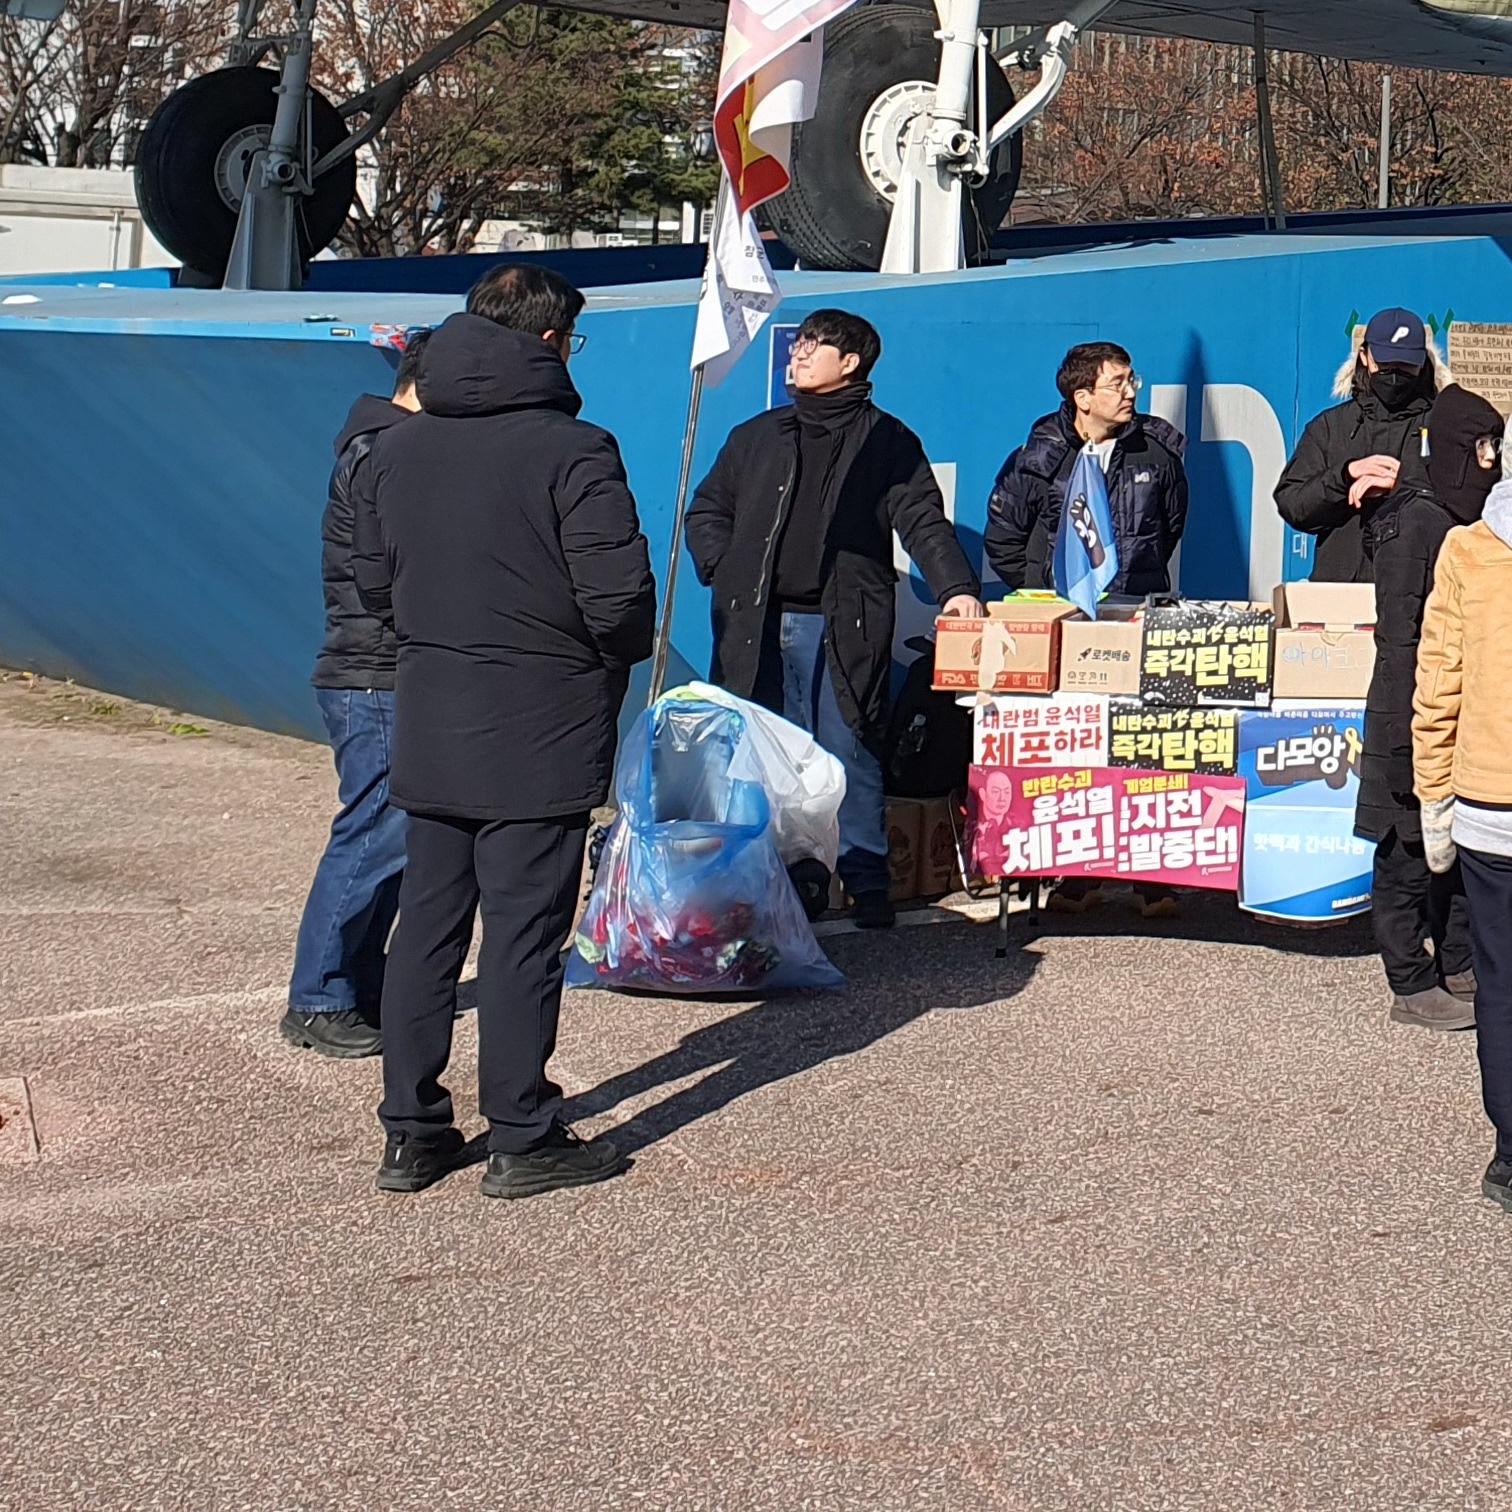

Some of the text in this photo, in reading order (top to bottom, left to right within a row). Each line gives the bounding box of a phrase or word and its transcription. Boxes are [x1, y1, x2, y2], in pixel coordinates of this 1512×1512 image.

[1147, 624, 1269, 647] 내란수괴 윤석열
[1091, 648, 1131, 662] 로켓배송
[1144, 642, 1269, 686] 즉각 탄핵
[941, 672, 966, 685] FDA
[980, 704, 1101, 731] 내란범 윤석열
[1112, 712, 1172, 732] 내란수괴
[1190, 711, 1236, 728] 윤석열
[981, 727, 1102, 767] 체포하라
[1111, 727, 1236, 769] 즉각 탄핵
[1256, 734, 1346, 774] 다모앙
[1022, 769, 1092, 798] 반란수괴
[1032, 784, 1114, 824] 윤석열
[1002, 815, 1116, 874] 체포!
